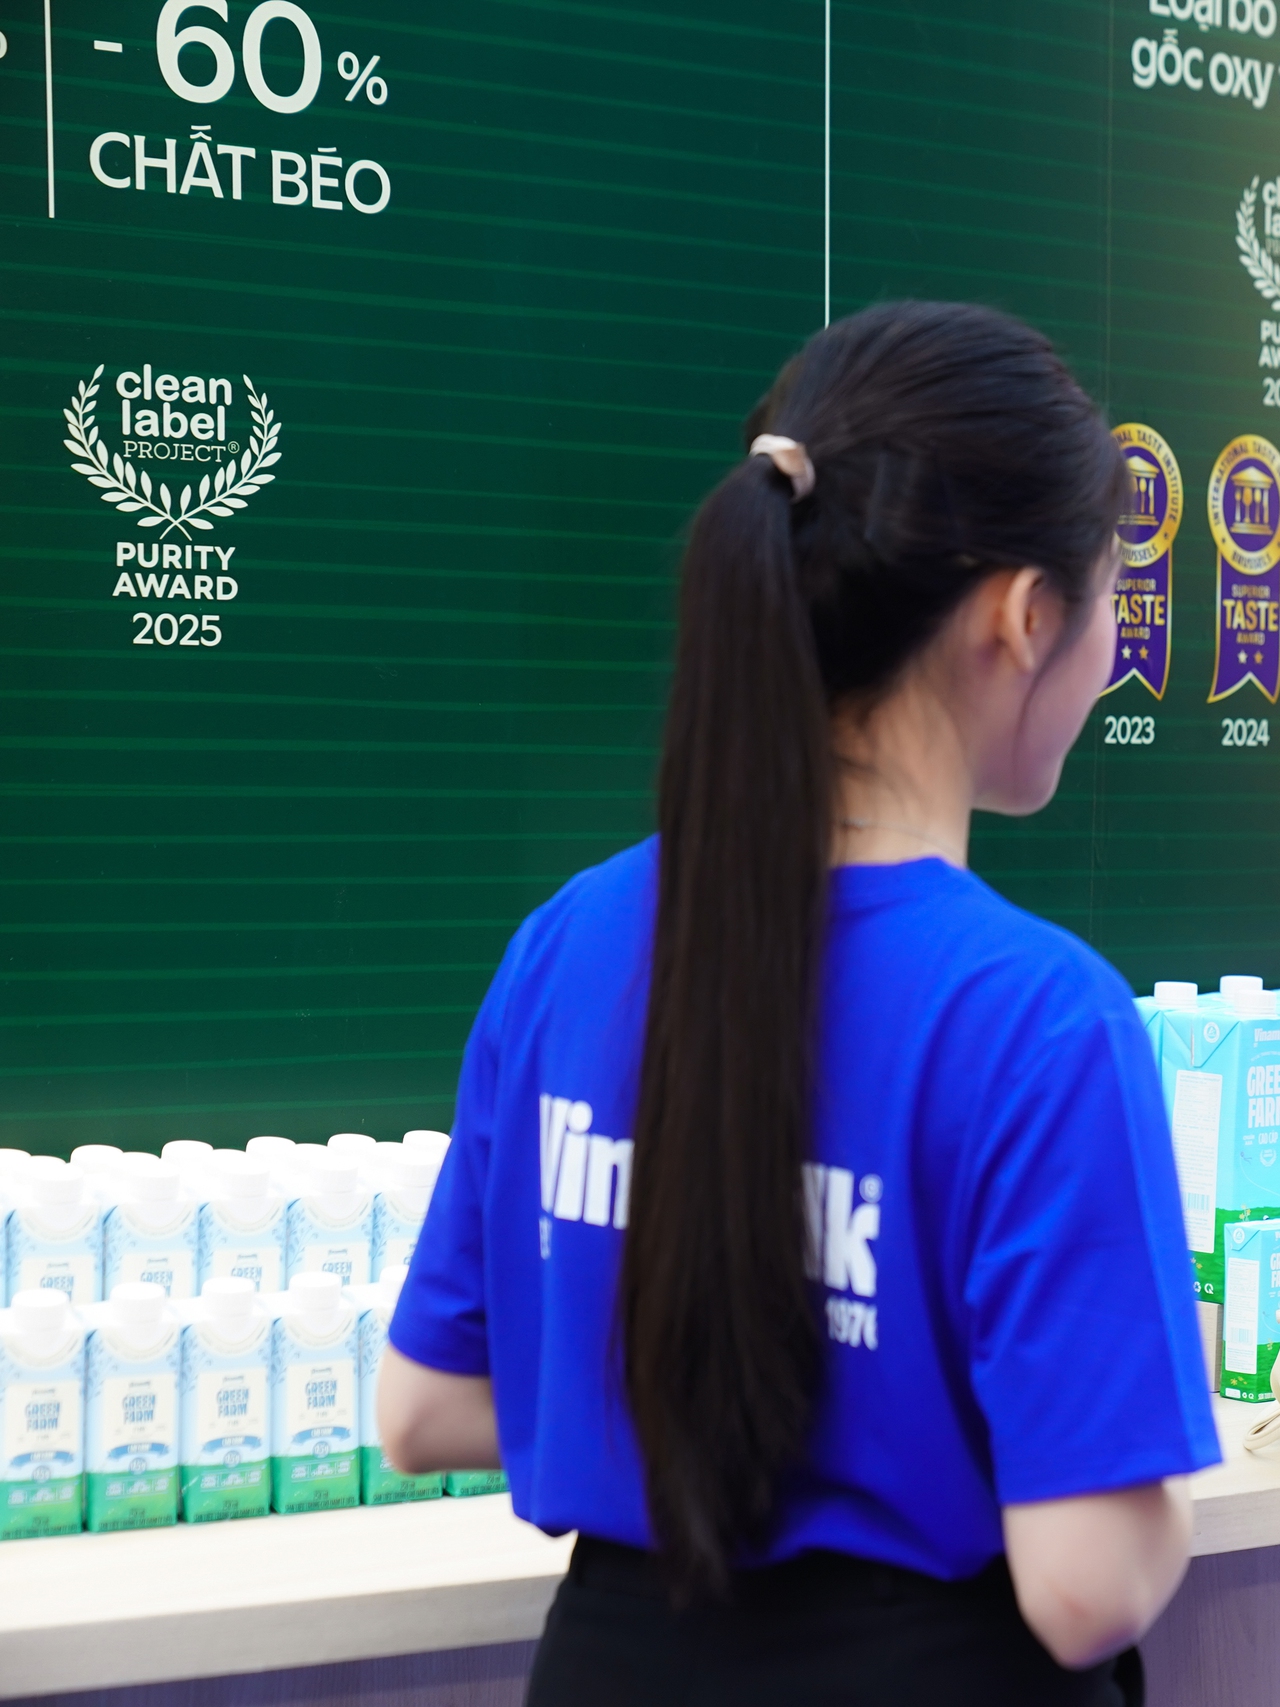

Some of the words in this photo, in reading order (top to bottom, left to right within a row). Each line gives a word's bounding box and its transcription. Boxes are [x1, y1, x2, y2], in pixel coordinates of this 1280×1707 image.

[1131, 28, 1204, 89] gốc
[1208, 52, 1275, 110] oxy
[115, 363, 232, 405] clean
[121, 399, 226, 441] label
[116, 542, 236, 571] PURITY
[112, 572, 239, 601] AWARD
[132, 612, 222, 647] 2025
[1222, 599, 1279, 632] TASTE
[1104, 716, 1155, 745] 2023
[1221, 718, 1270, 746] 2024
[122, 1394, 156, 1410] GREEN
[217, 1388, 249, 1404] GREEN
[305, 1379, 337, 1396] GREEN
[307, 1394, 336, 1410] FARM
[218, 1403, 248, 1418] FARM
